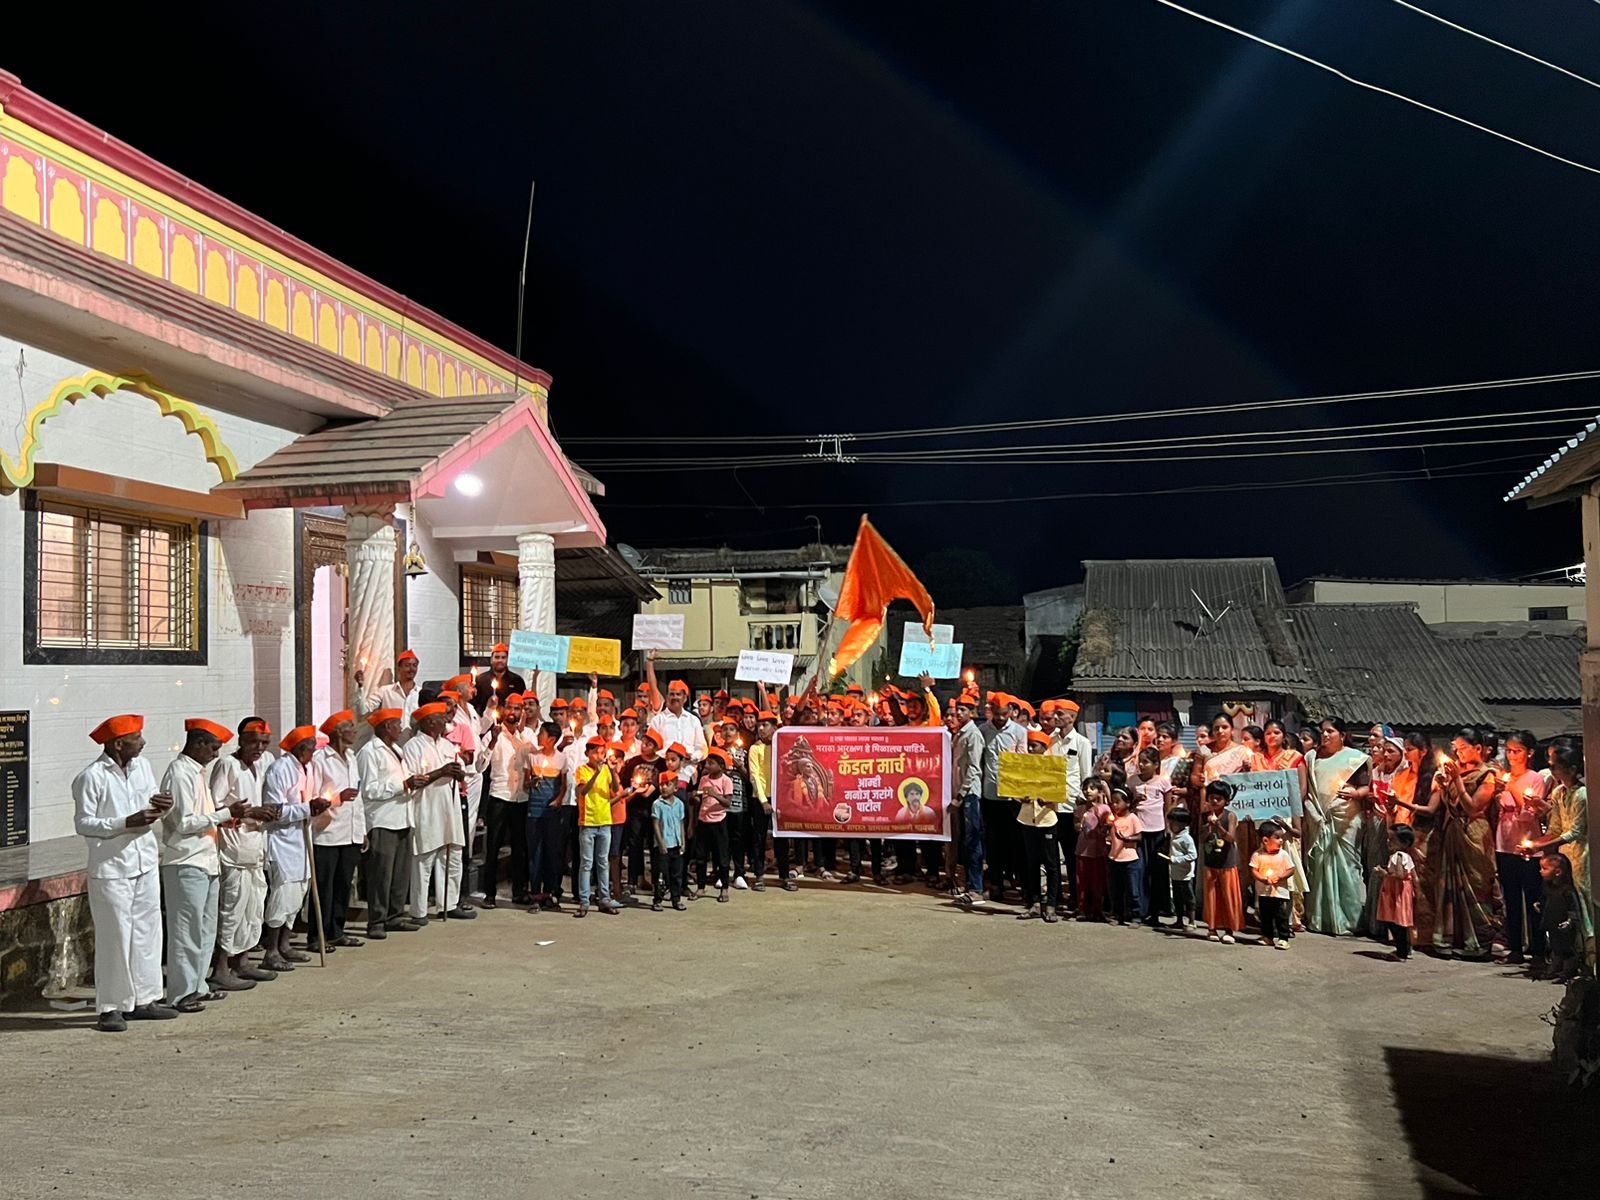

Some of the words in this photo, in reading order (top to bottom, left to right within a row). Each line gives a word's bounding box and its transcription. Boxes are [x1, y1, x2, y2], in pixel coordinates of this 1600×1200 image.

[815, 744, 835, 753] मराठा
[837, 744, 863, 753] आरक्षण
[864, 743, 871, 753] हे
[875, 753, 906, 775] मार्च
[857, 775, 882, 788] आम्ही
[1254, 780, 1283, 793] मराठा
[844, 788, 870, 800] मनोज
[871, 786, 894, 800] जरांगे
[856, 799, 882, 812] पाटील
[1231, 798, 1255, 810] लाख
[1259, 796, 1291, 810] मराठा
